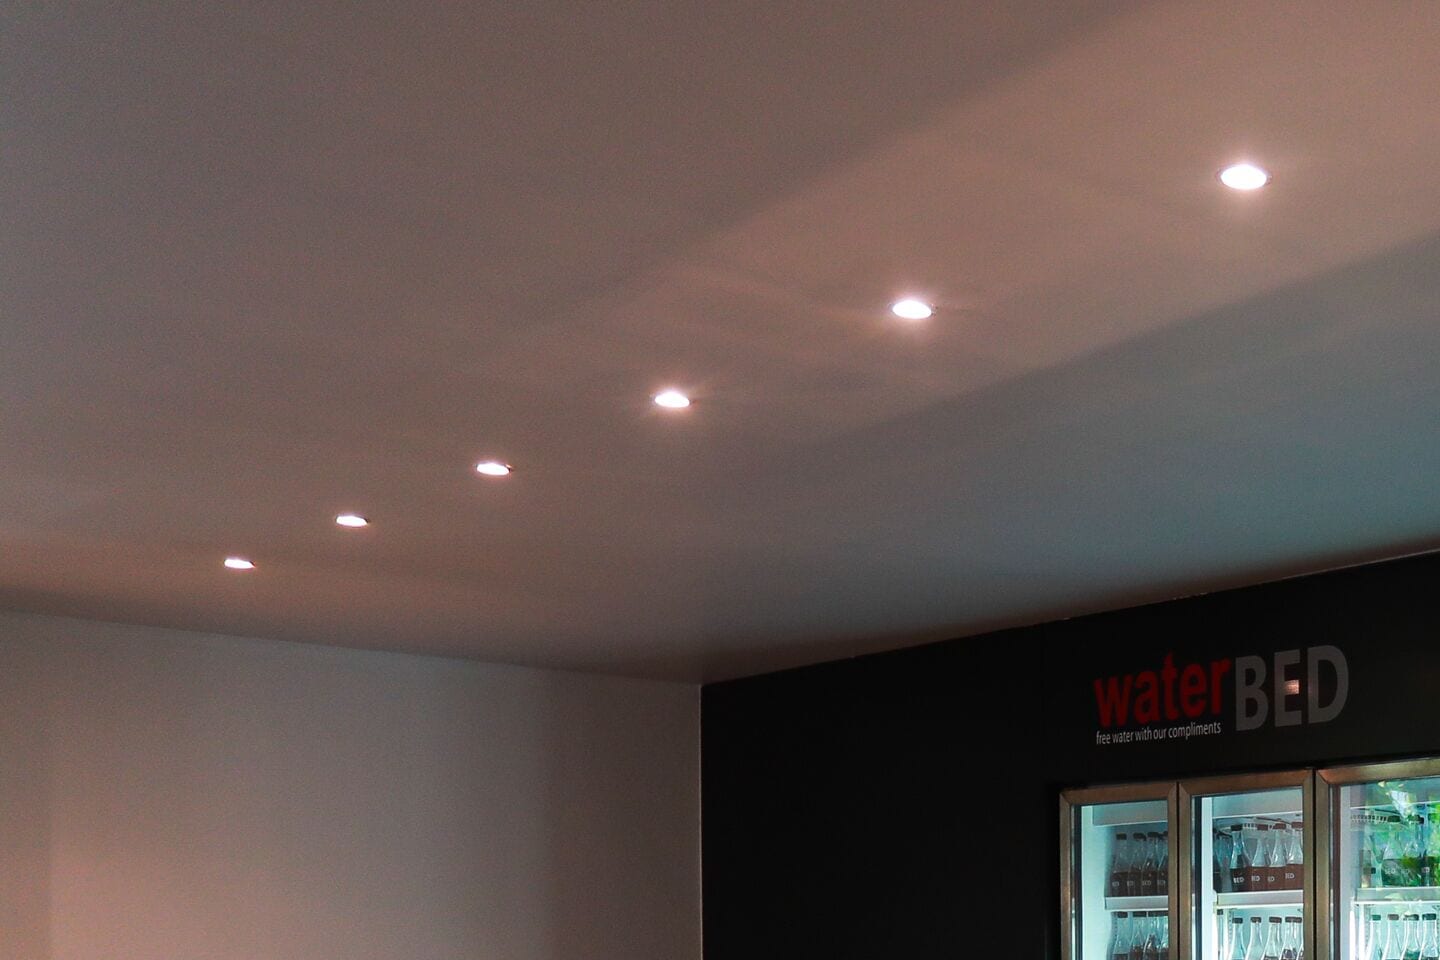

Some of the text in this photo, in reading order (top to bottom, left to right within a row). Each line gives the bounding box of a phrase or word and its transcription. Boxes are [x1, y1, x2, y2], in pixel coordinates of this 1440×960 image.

[1096, 721, 1222, 745] free water with our compliments
